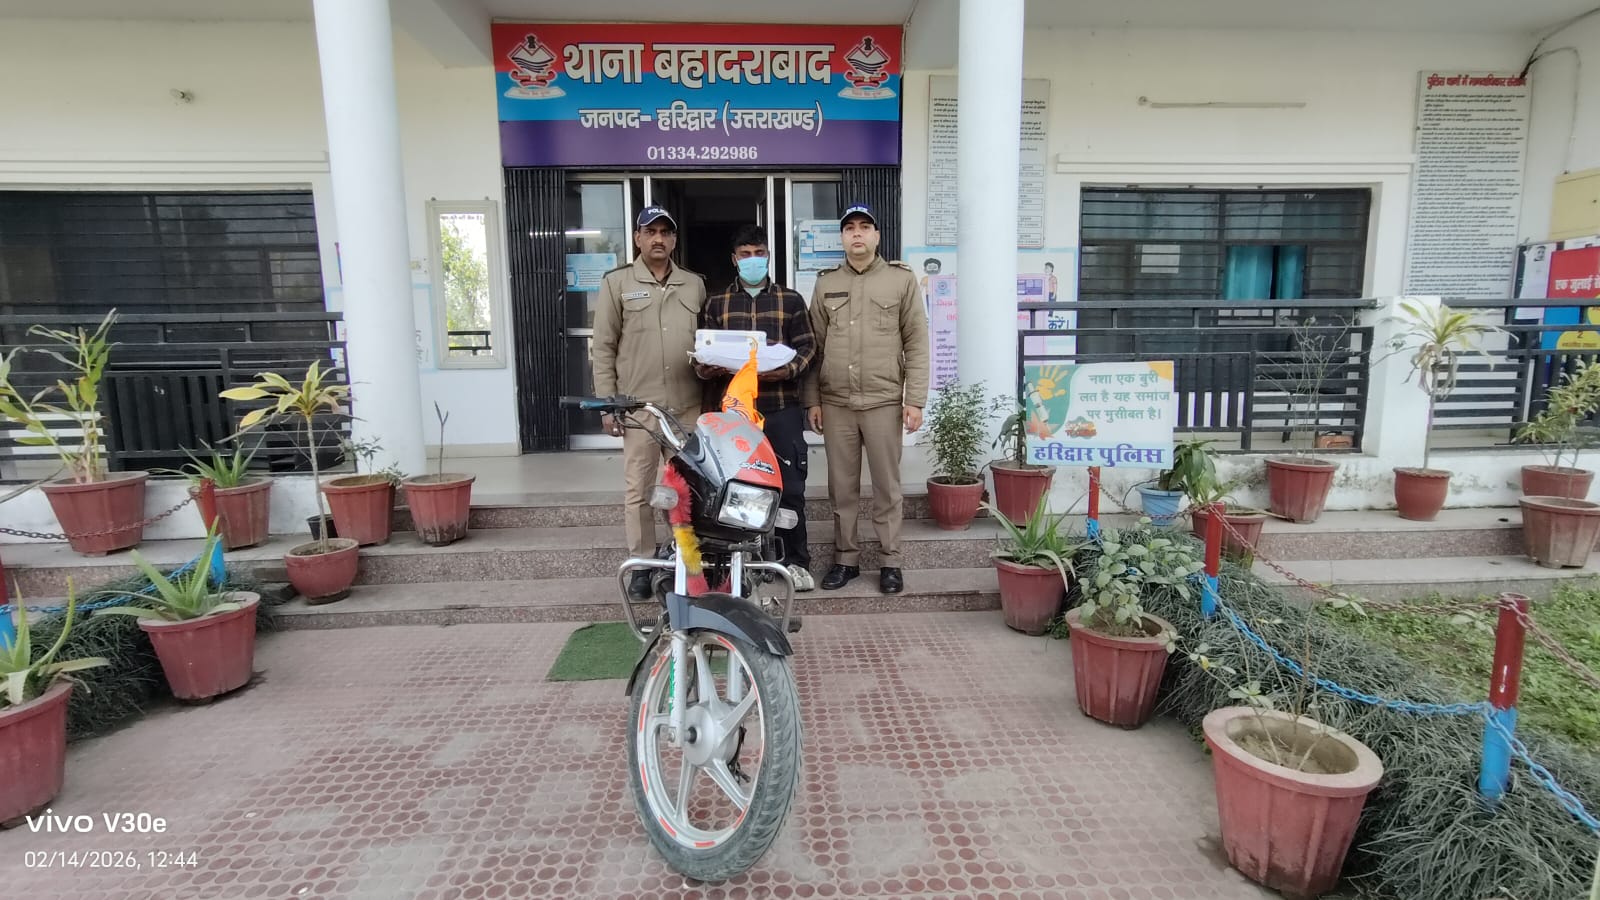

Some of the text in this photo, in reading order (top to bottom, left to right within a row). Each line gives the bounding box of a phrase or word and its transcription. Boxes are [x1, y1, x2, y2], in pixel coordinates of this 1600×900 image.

[563, 42, 835, 89] थाना बहादराबाद
[656, 99, 718, 132] हरिद्वार
[721, 100, 824, 137] (उत्तराखण्ड)
[647, 145, 758, 161] 01334.292986
[1555, 279, 1569, 290] एक
[1570, 275, 1593, 294] जुलाई
[1088, 370, 1159, 387] नशा एक बुरी
[1079, 391, 1098, 403] लत
[1101, 389, 1110, 402] है
[1113, 391, 1130, 403] यह
[1085, 409, 1101, 420] पर
[1104, 406, 1144, 424] मुसीबत
[1032, 442, 1166, 468] हरिद्वार पुलिस
